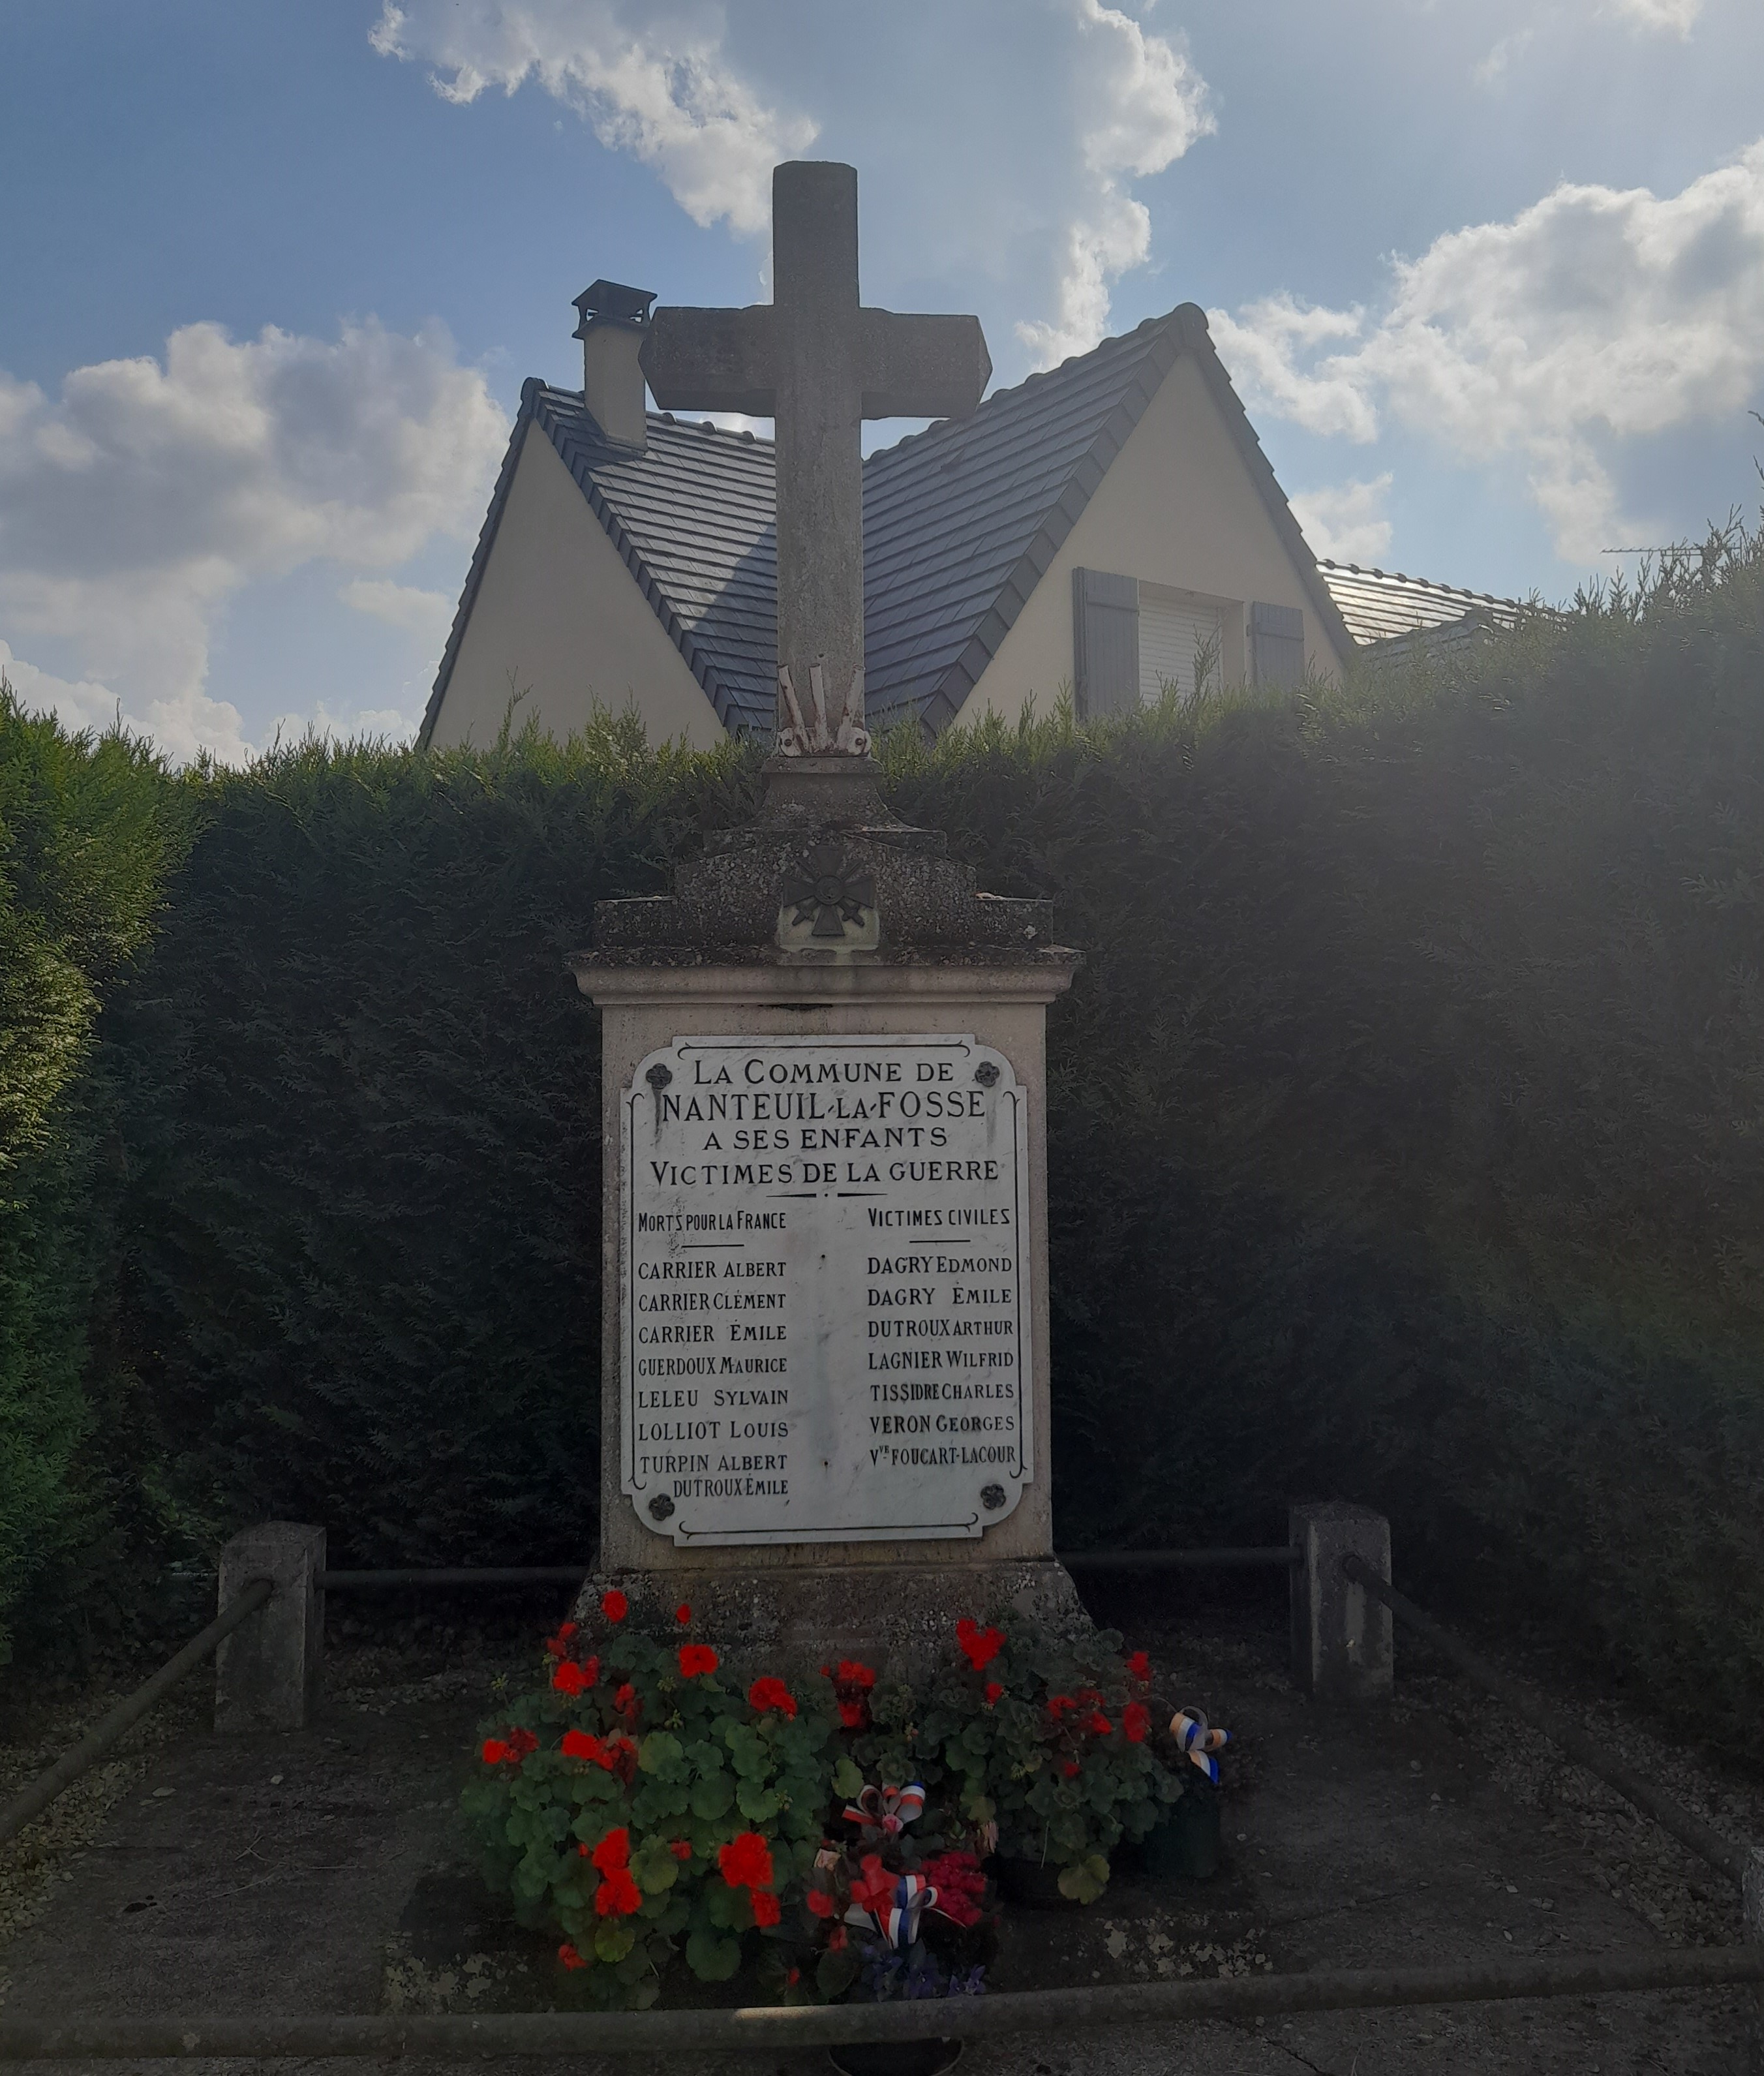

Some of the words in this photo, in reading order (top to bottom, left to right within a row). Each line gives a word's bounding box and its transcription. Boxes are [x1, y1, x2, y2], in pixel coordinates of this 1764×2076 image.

[693, 1060, 733, 1085] LA
[744, 1058, 902, 1084] COMMUNE
[916, 1062, 955, 1082] DE
[701, 1131, 723, 1151] A
[733, 1129, 790, 1150] SES
[800, 1127, 948, 1149] ENFANTS
[650, 1160, 793, 1185] VICTIMES
[802, 1163, 837, 1183] DE
[847, 1163, 881, 1183] LA
[889, 1160, 999, 1182] GUERRE
[638, 1212, 683, 1232] MORTS
[686, 1214, 717, 1231] POUR
[718, 1214, 733, 1230] LA
[737, 1210, 787, 1230] FRANCE
[868, 1208, 943, 1227] VICTIMES
[948, 1208, 1011, 1225] CIVILES
[638, 1260, 718, 1280] CARRIER
[723, 1260, 787, 1278] ALBERT
[867, 1256, 934, 1275] DAGRY
[936, 1256, 1012, 1273] EDMOND
[638, 1292, 710, 1312] CARRIER
[867, 1287, 936, 1306] DAGRY
[638, 1324, 715, 1344] CARRIER
[867, 1319, 950, 1337] DUTROUX
[952, 1319, 1014, 1336] ARTHUR
[638, 1356, 716, 1376] GUERDOUX
[719, 1356, 787, 1375] MAURICE
[868, 1351, 943, 1370] LAGNIER
[945, 1350, 1014, 1368] WILFRID
[638, 1389, 699, 1409] LELEU
[714, 1389, 789, 1407] SYLVAIN
[870, 1383, 939, 1401] TISSIDRE
[941, 1382, 1014, 1399] CHARLES
[638, 1421, 721, 1441] LOLLIOT
[730, 1420, 789, 1439] LOUIS
[869, 1414, 931, 1434] VERON
[935, 1414, 1014, 1433] GEORGES
[639, 1454, 710, 1474] TURPIN
[717, 1454, 788, 1472] ALBERT
[891, 1445, 1016, 1466] FOUCART-LACOUR
[673, 1478, 742, 1498] DUTROUX
